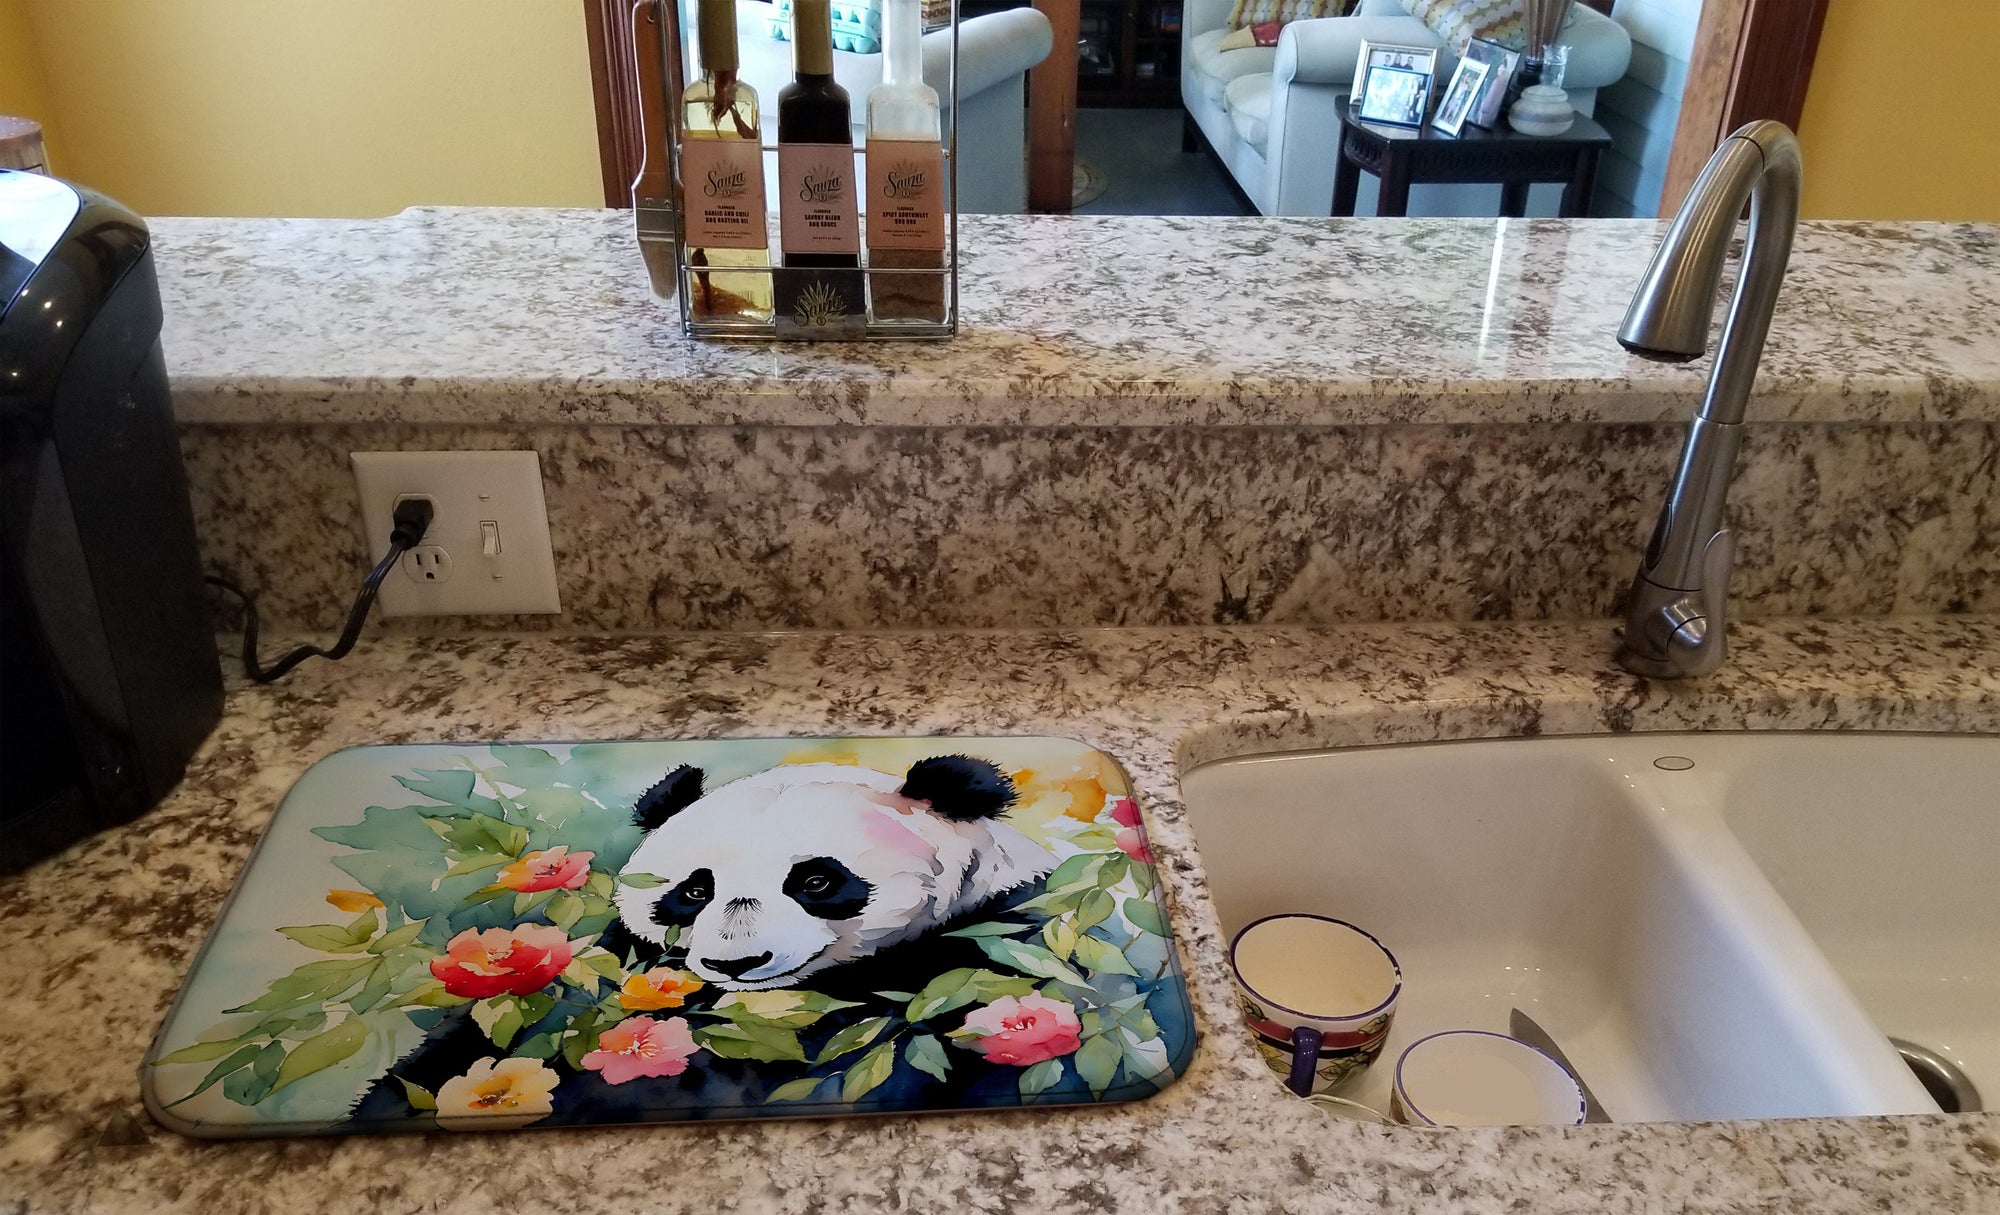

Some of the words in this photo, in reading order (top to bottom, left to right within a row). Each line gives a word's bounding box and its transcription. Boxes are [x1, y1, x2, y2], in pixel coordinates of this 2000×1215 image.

[704, 170, 745, 197] Sauza
[800, 175, 841, 202] Sauza
[884, 171, 924, 198] Sauza
